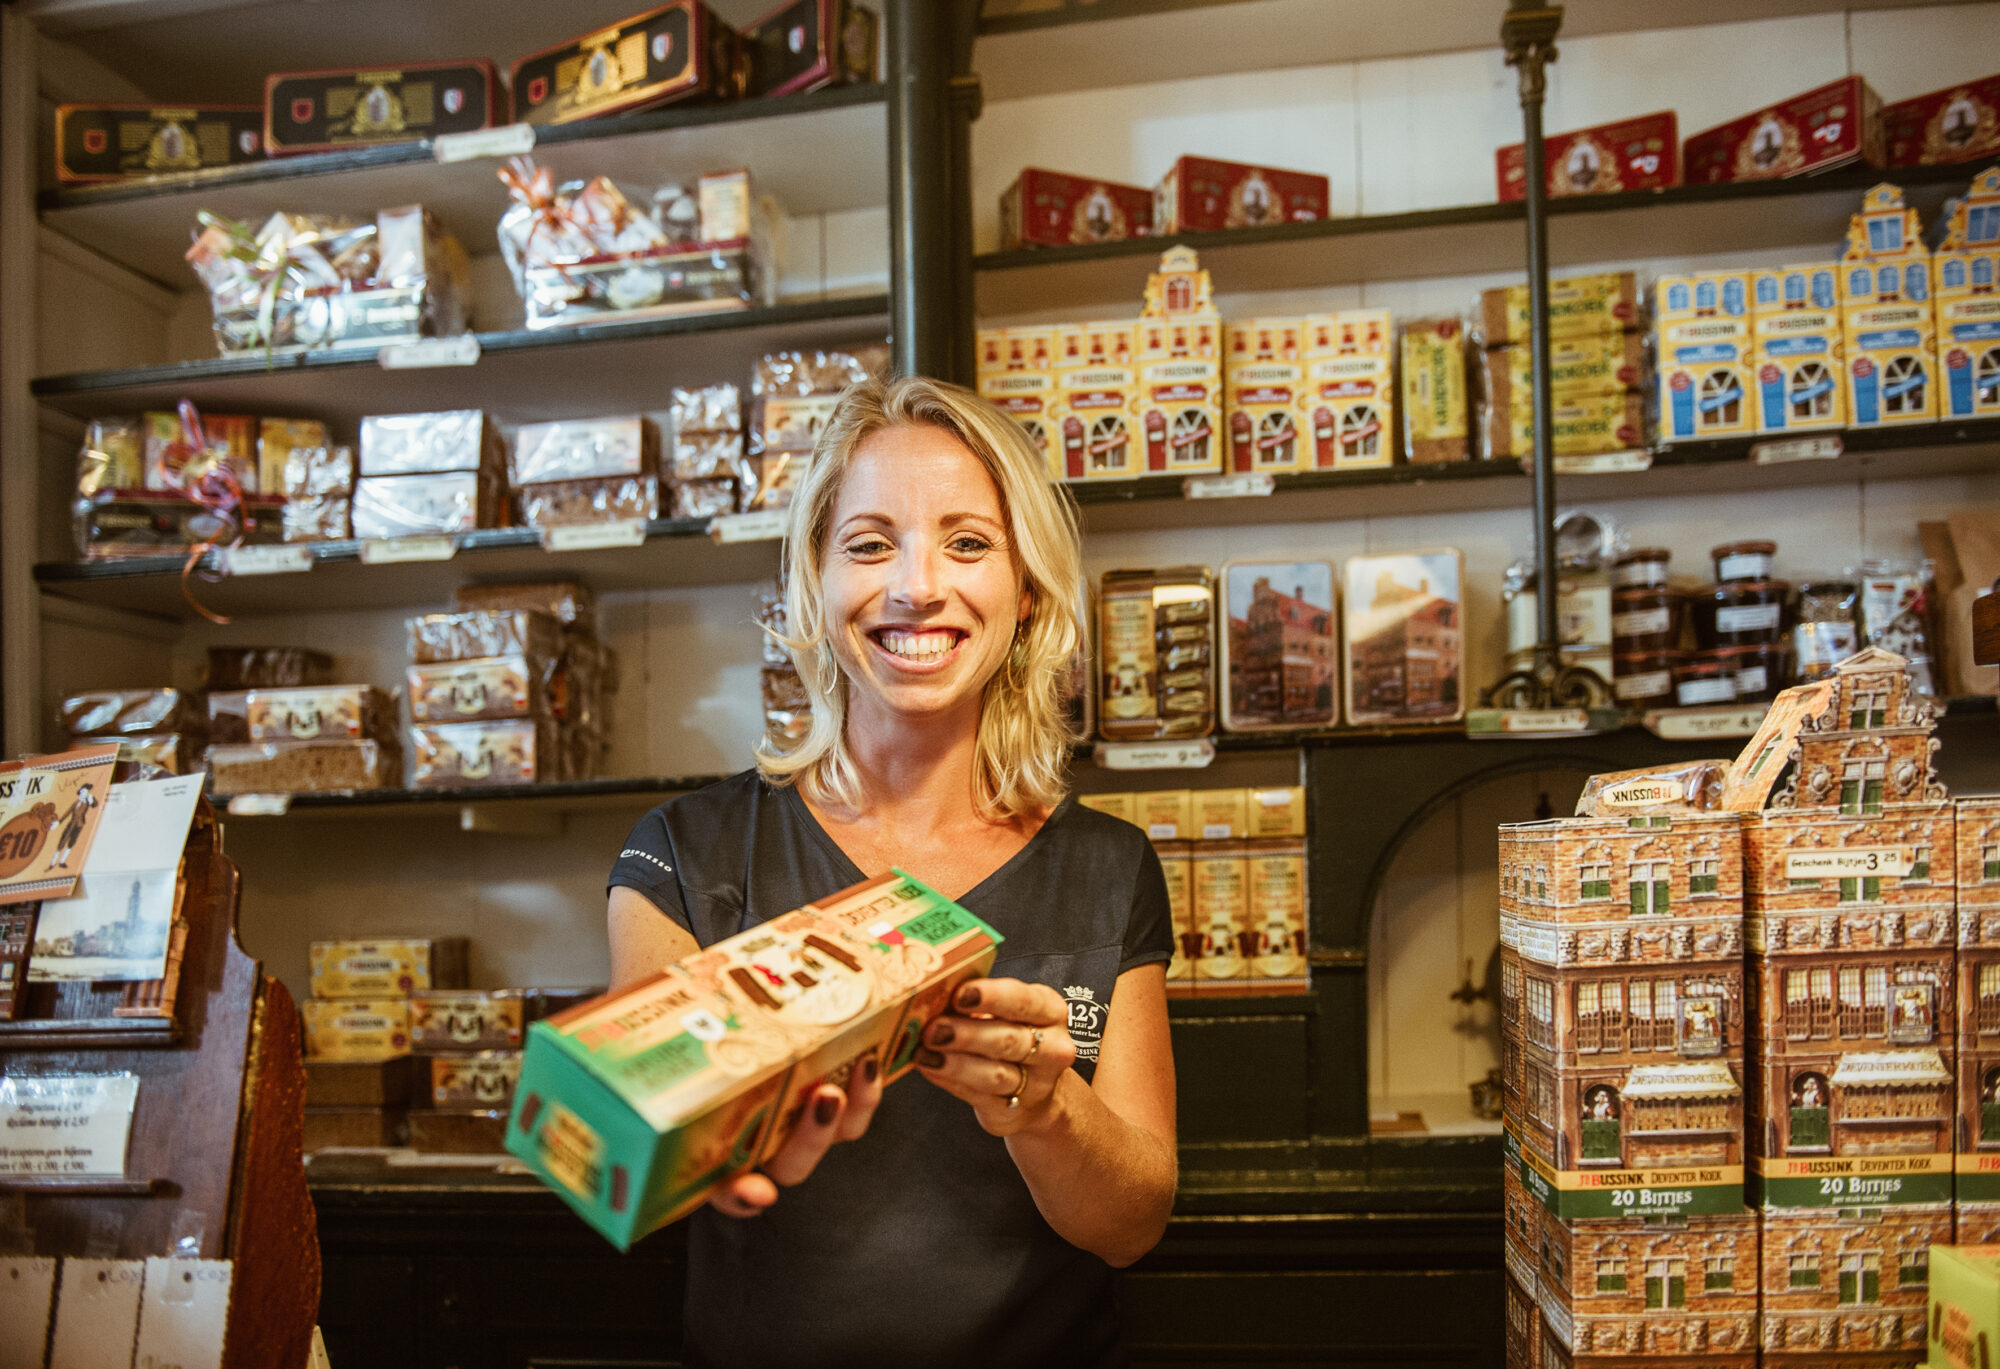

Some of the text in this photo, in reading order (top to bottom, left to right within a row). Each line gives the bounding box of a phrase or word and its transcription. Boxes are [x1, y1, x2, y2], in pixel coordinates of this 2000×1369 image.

[1612, 787, 1661, 803] BUSSINK
[1791, 853, 1897, 871] Geschenk Bijtjes 3 25
[1800, 1160, 1853, 1174] BUSSINK
[1860, 1158, 1906, 1172] DEVENTER
[1908, 1157, 1931, 1170] KOEK
[1592, 1172, 1645, 1187] BUSSINK
[1652, 1171, 1697, 1185] DEVENTER
[1699, 1170, 1722, 1183] KOEK
[1820, 1177, 1844, 1195] 20
[1611, 1189, 1635, 1207] 20
